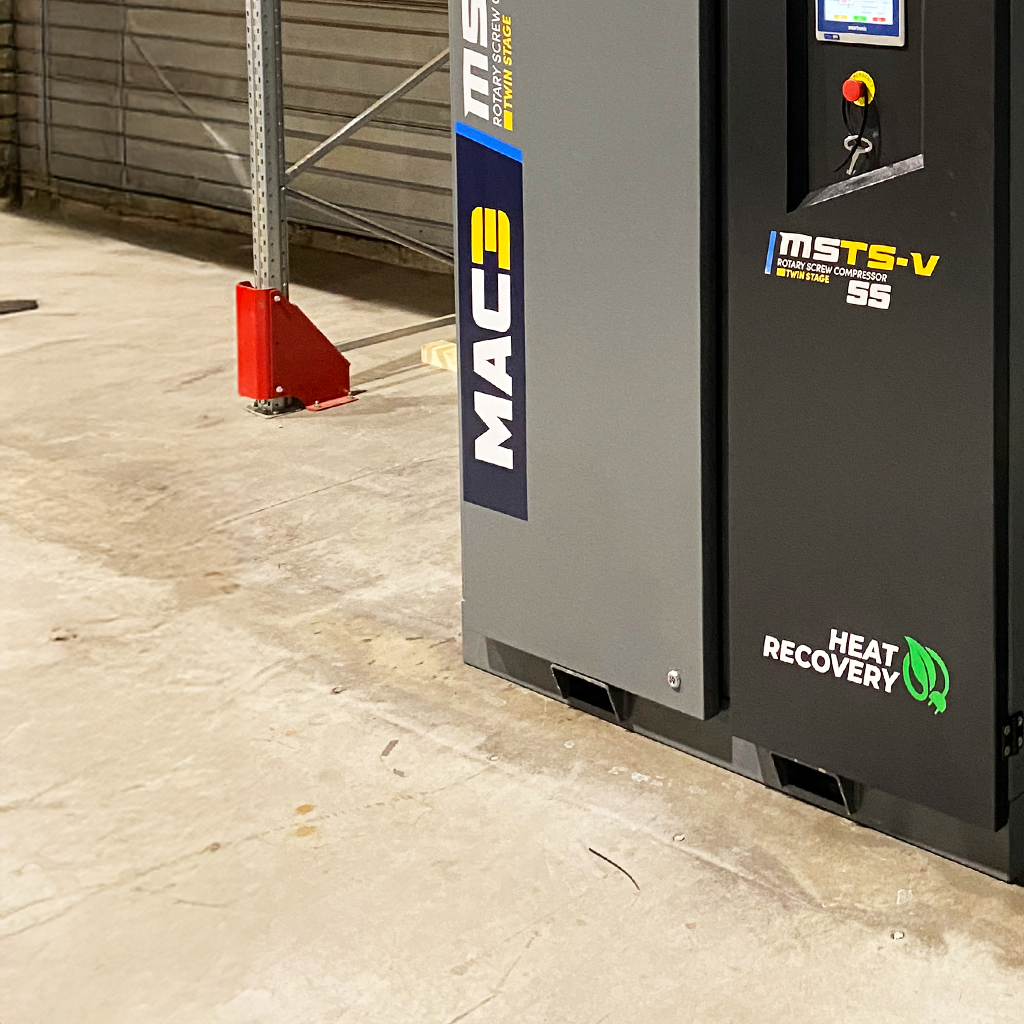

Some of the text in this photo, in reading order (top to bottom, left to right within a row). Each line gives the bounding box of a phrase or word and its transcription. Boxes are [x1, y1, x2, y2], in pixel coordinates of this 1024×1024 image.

[491, 7, 502, 64] SCREW
[502, 15, 513, 109] TWIN STAGE
[493, 65, 503, 128] ROTARY
[777, 258, 888, 283] ROTARY SCREW COMPRESSOR
[786, 269, 830, 284] TWIN STAGE
[846, 280, 892, 310] 55
[471, 206, 514, 470] MAC3
[762, 634, 901, 694] RECOVERY
[828, 628, 900, 667] HEAT
